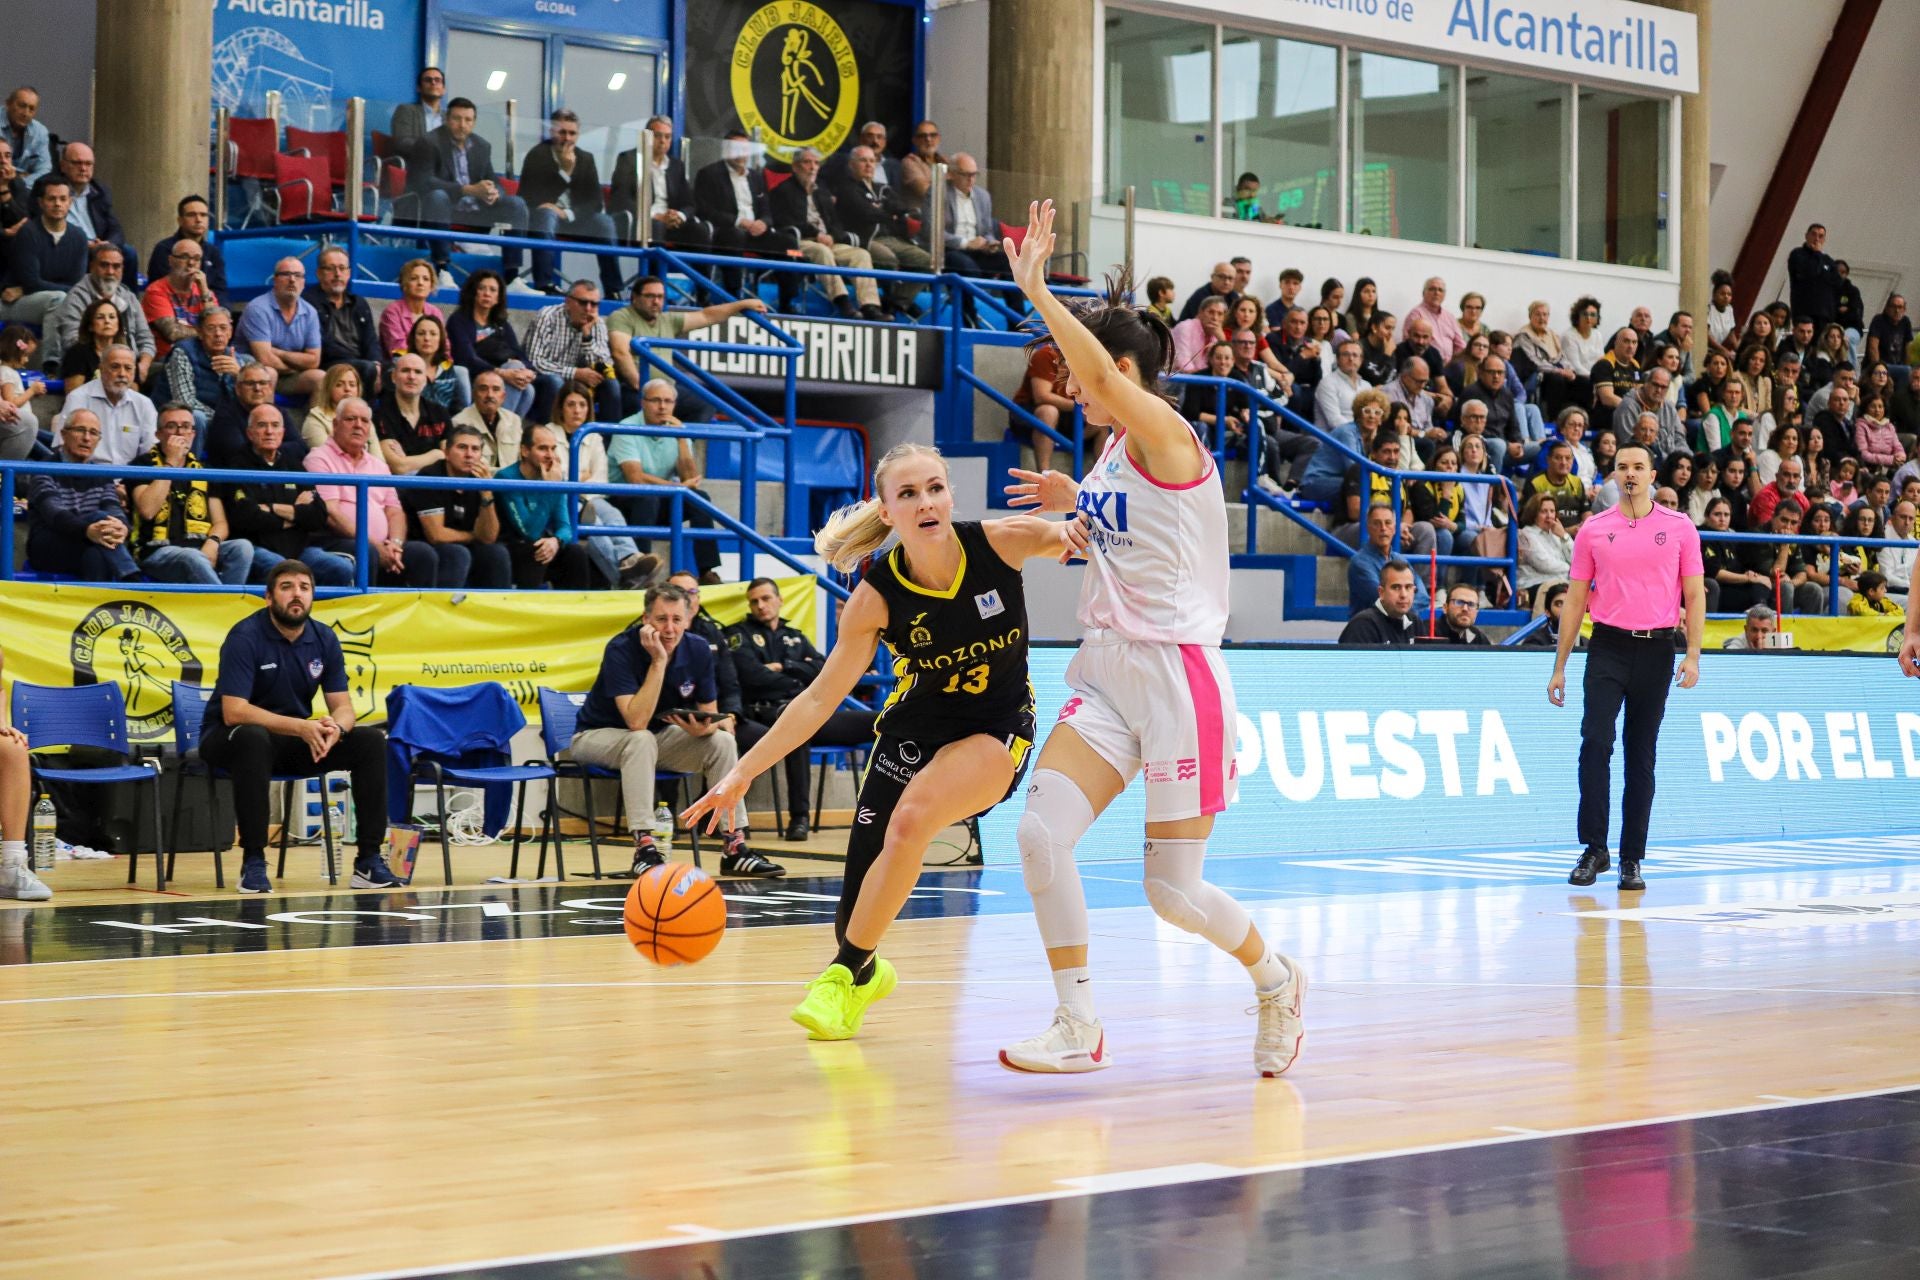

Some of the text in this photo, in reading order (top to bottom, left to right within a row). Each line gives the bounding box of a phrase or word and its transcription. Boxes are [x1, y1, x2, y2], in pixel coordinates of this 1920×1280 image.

[535, 1, 576, 16] GLOBAL
[1386, 0, 1414, 22] de
[735, 3, 855, 79] CLUB JAIRIS
[1446, 0, 1679, 76] Alcantarilla
[74, 605, 193, 663] CLUB JAIRIS
[918, 627, 1021, 670] HOZONO
[421, 660, 547, 678] Ayuntamiento de
[942, 663, 990, 694] 13
[878, 753, 900, 773] Costa
[1700, 711, 1822, 782] POR
[1824, 711, 1895, 780] EL
